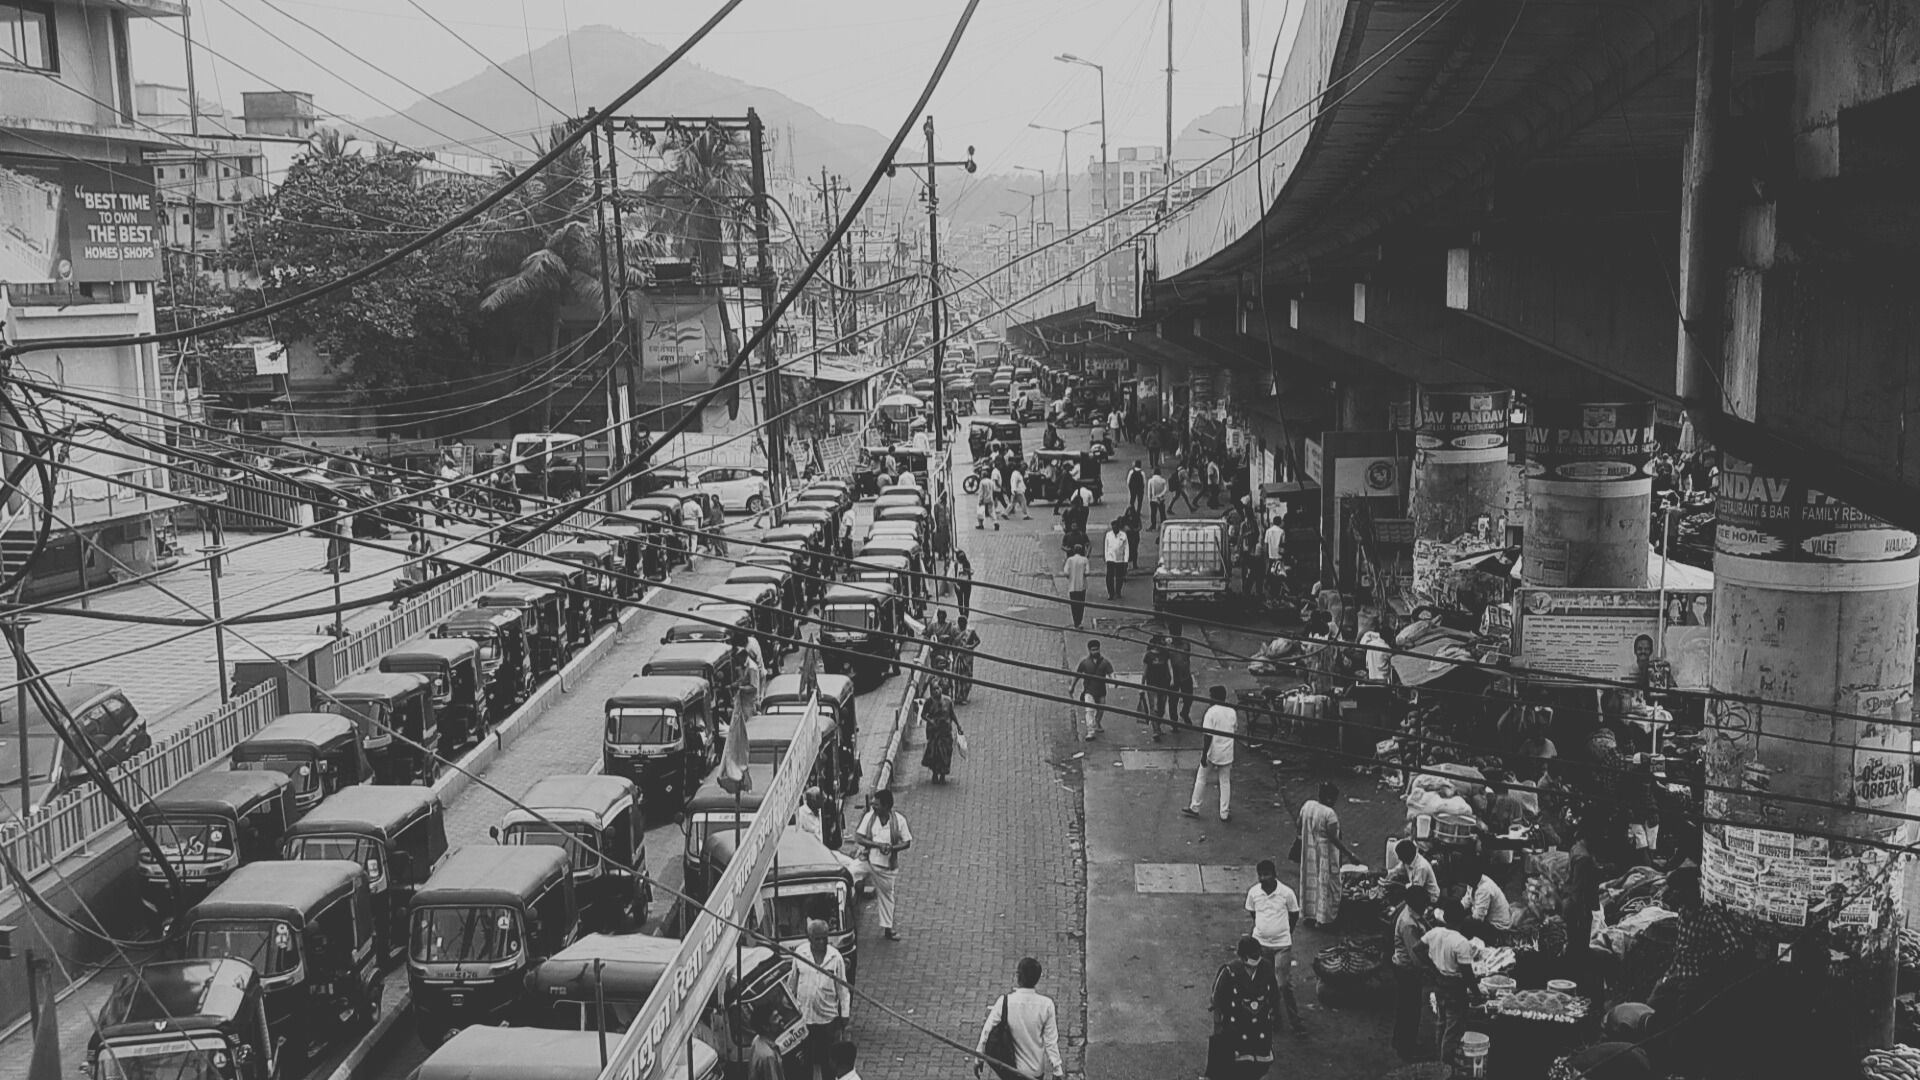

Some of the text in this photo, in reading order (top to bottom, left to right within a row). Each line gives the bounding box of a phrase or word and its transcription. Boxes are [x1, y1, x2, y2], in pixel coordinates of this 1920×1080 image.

[119, 193, 151, 210] TIME
[99, 211, 138, 224] TO OWN
[88, 225, 153, 243] THE BEST
[84, 246, 118, 259] HOMES
[1452, 408, 1505, 425] PANDAV
[1558, 428, 1638, 446] PANDAV
[1769, 504, 1791, 519] BAR
[1801, 506, 1840, 521] FAMILY
[1732, 531, 1768, 545] HOME
[1811, 539, 1837, 555] VALET
